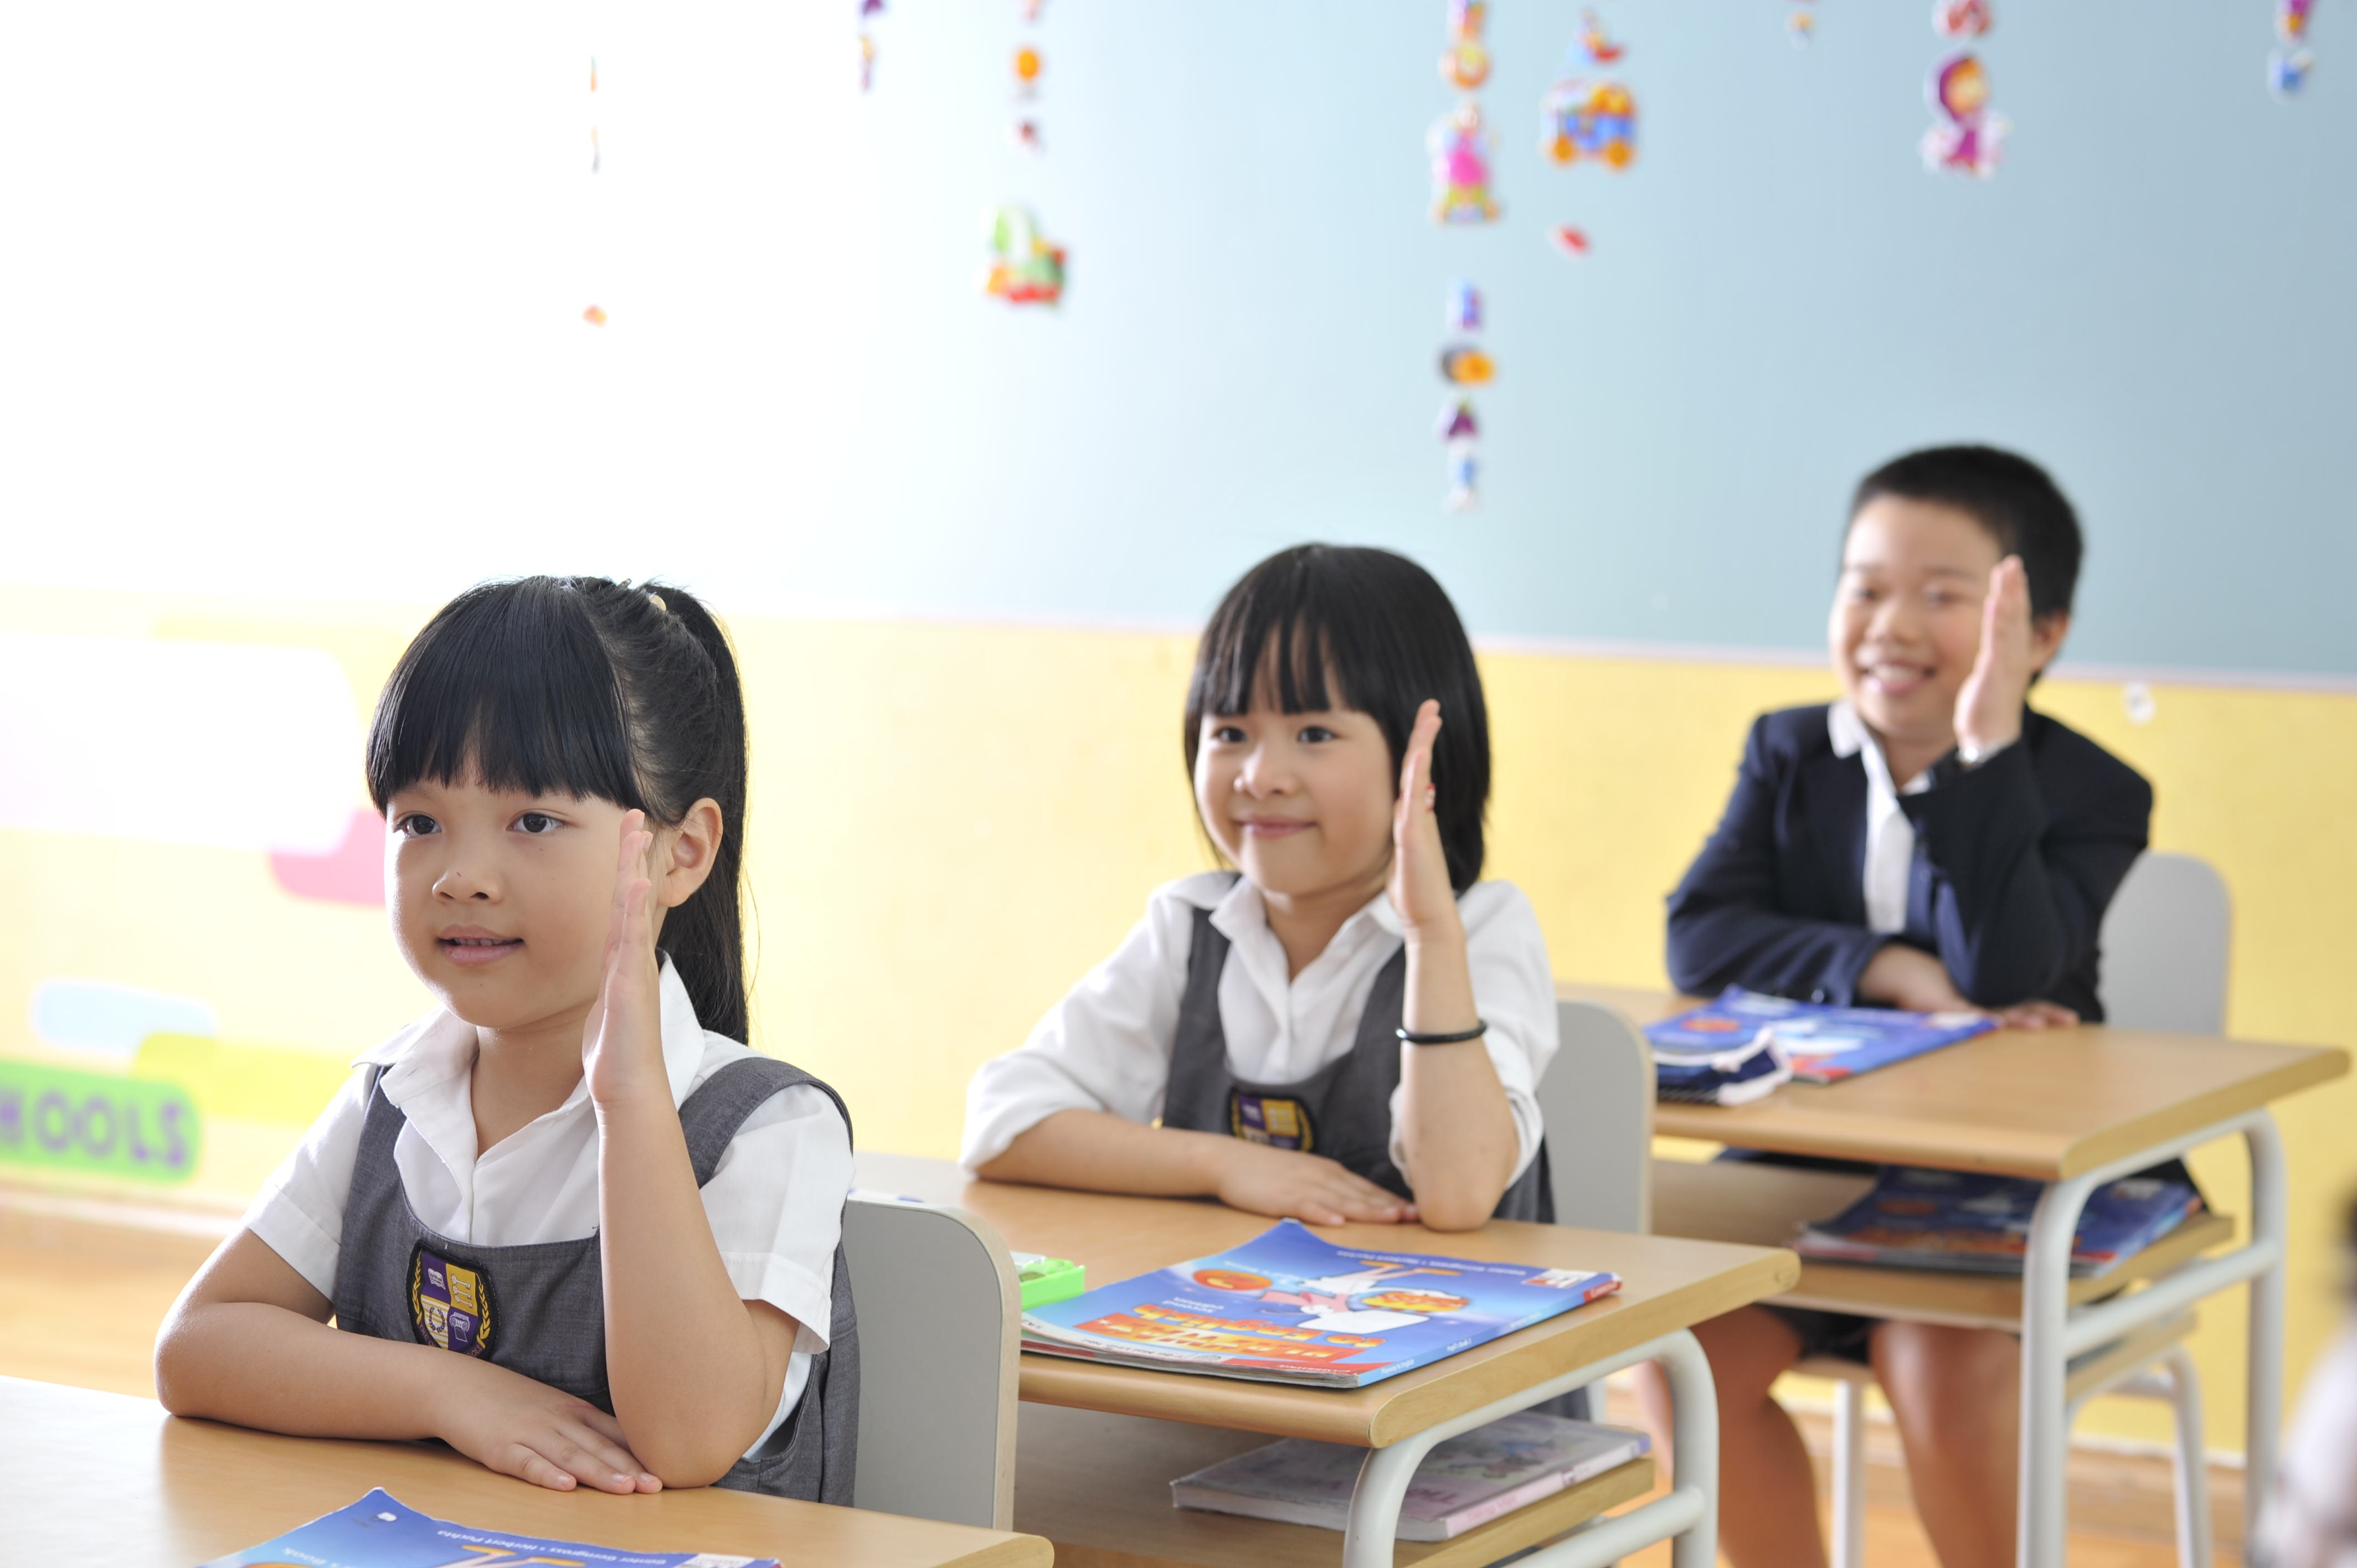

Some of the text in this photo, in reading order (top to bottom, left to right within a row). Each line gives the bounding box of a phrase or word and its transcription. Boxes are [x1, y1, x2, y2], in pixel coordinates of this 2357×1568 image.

[1107, 1319, 1335, 1360] PLAYWAY
[1133, 1304, 1385, 1348] to English
[437, 1530, 483, 1543] Puchta
